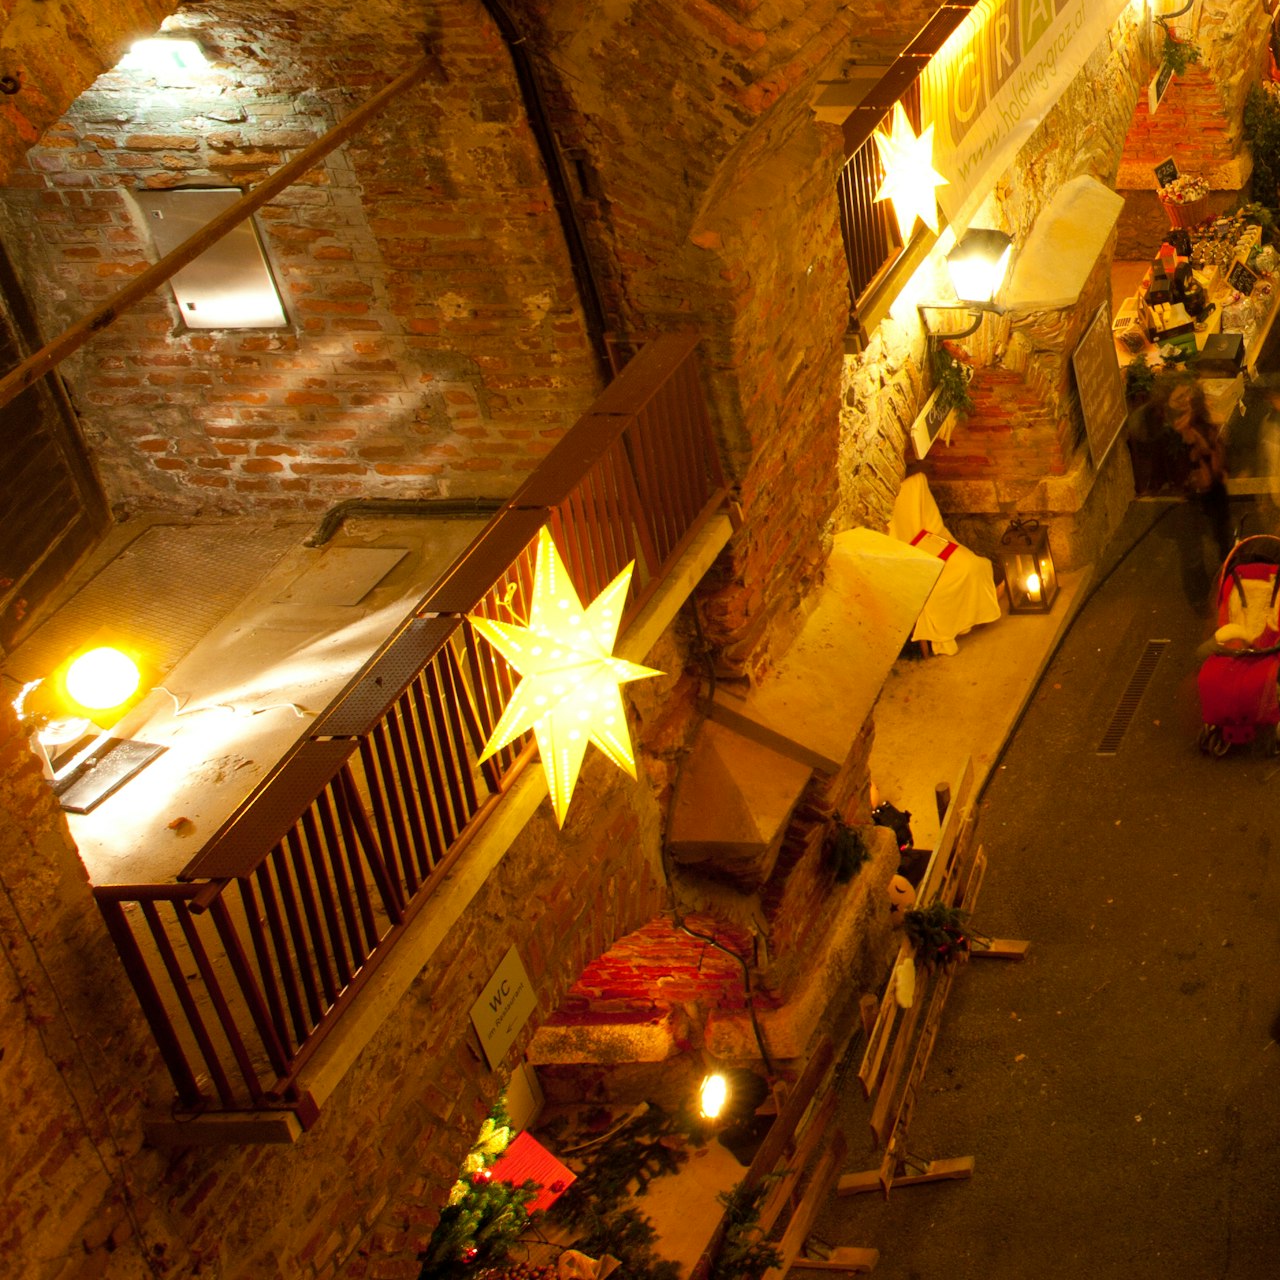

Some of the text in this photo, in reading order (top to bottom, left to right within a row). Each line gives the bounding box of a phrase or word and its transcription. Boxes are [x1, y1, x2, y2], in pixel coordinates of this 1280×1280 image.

[957, 0, 1086, 182] www.holding-graz.at
[489, 979, 510, 1012] WC
[495, 982, 525, 1026] Restaurant
